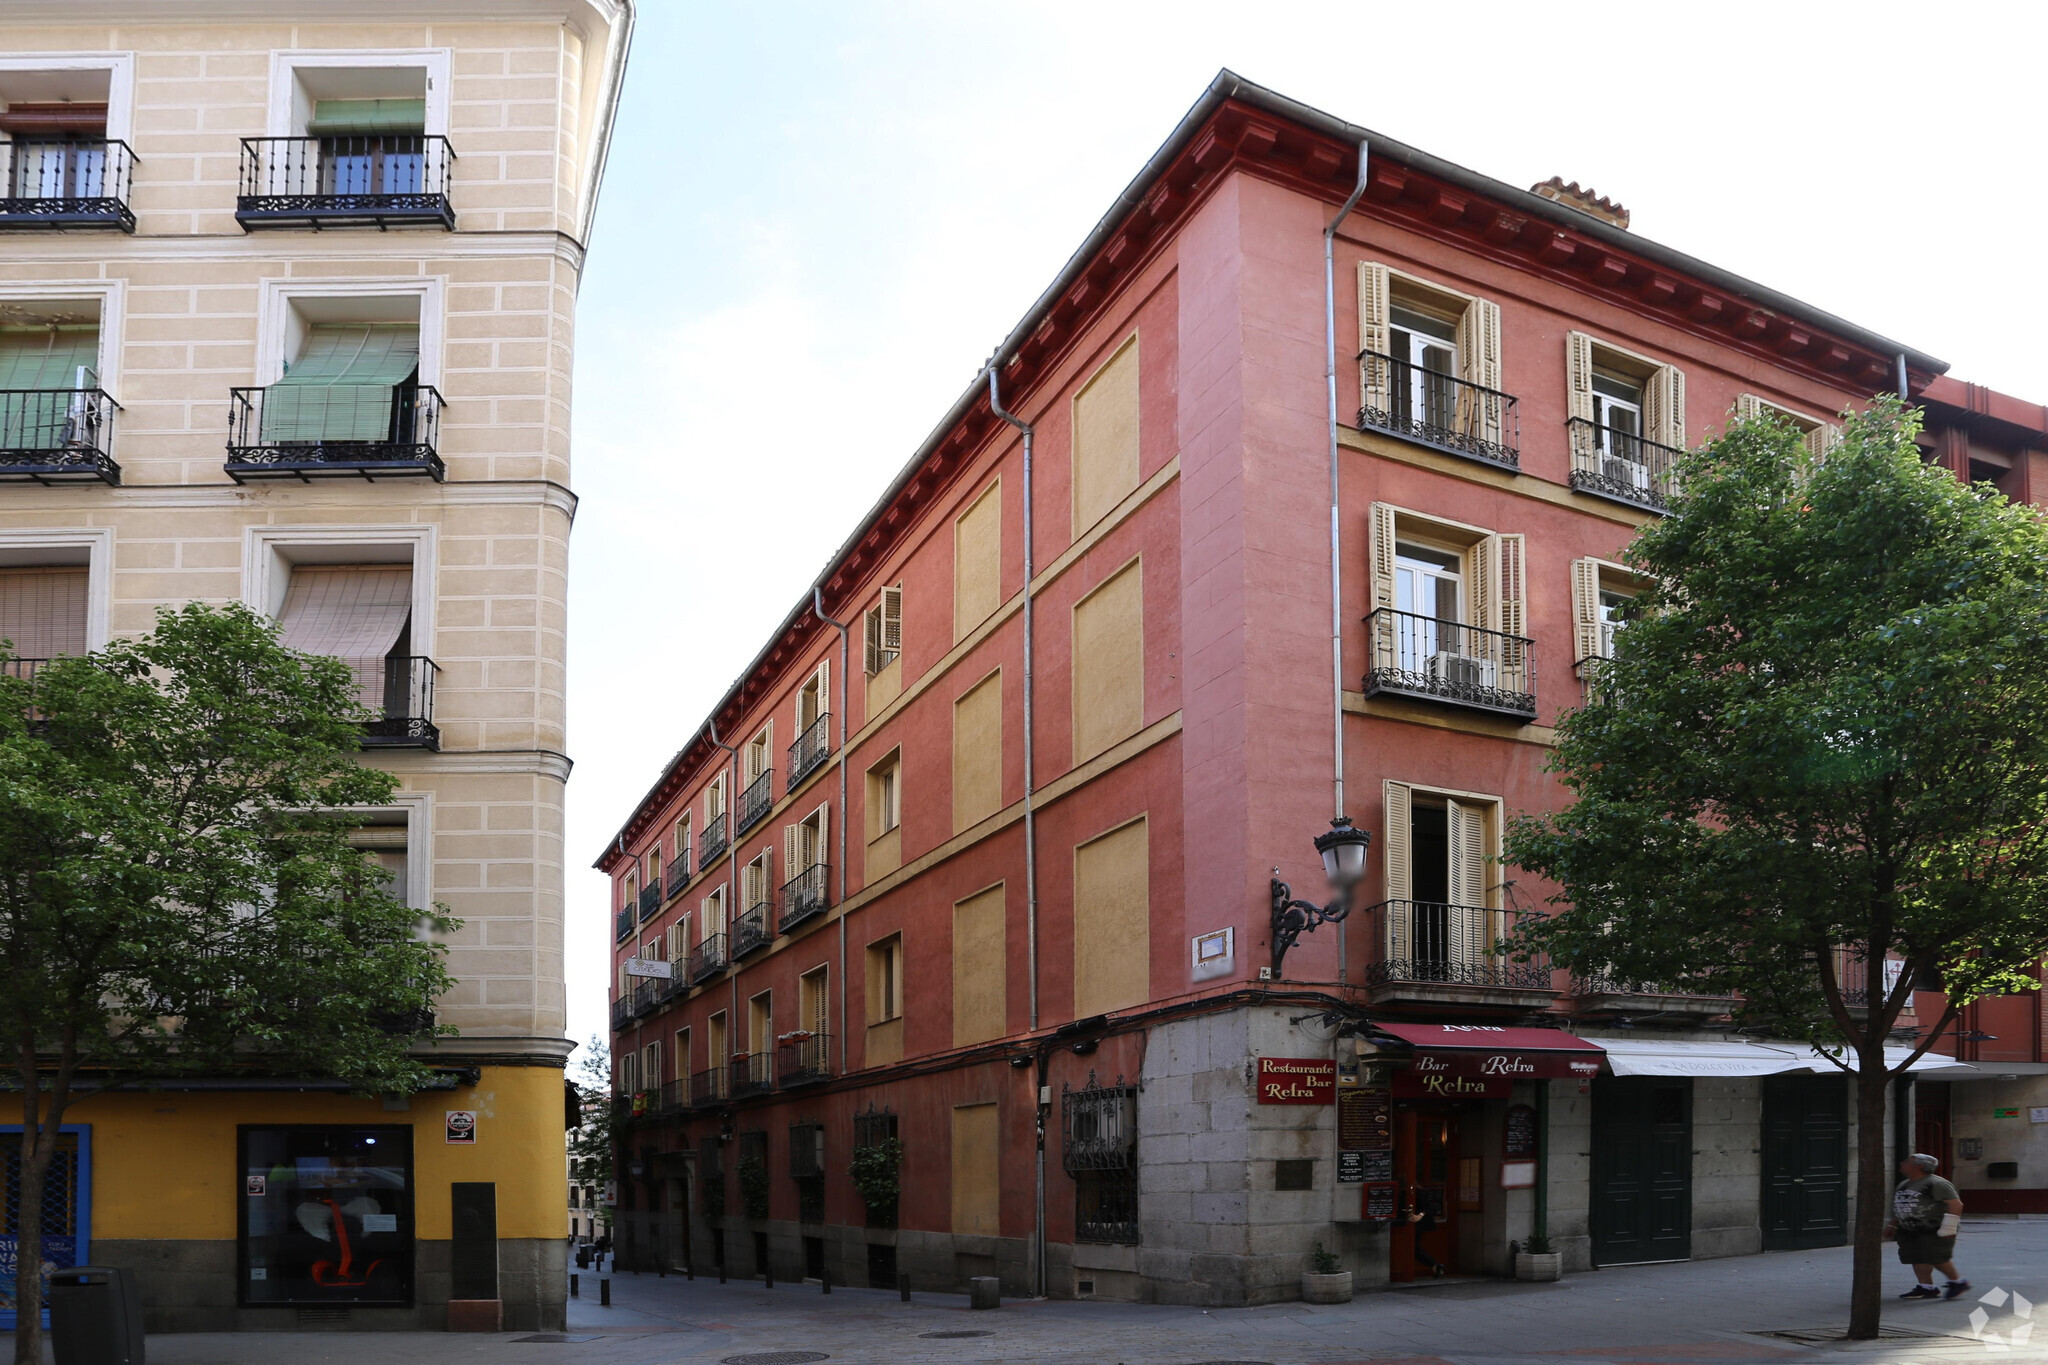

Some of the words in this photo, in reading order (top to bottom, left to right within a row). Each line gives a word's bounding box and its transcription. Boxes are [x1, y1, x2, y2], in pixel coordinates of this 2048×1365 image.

[1262, 1059, 1334, 1074] Restaurante
[1419, 1056, 1449, 1071] Bar
[1306, 1075, 1332, 1087] Bar
